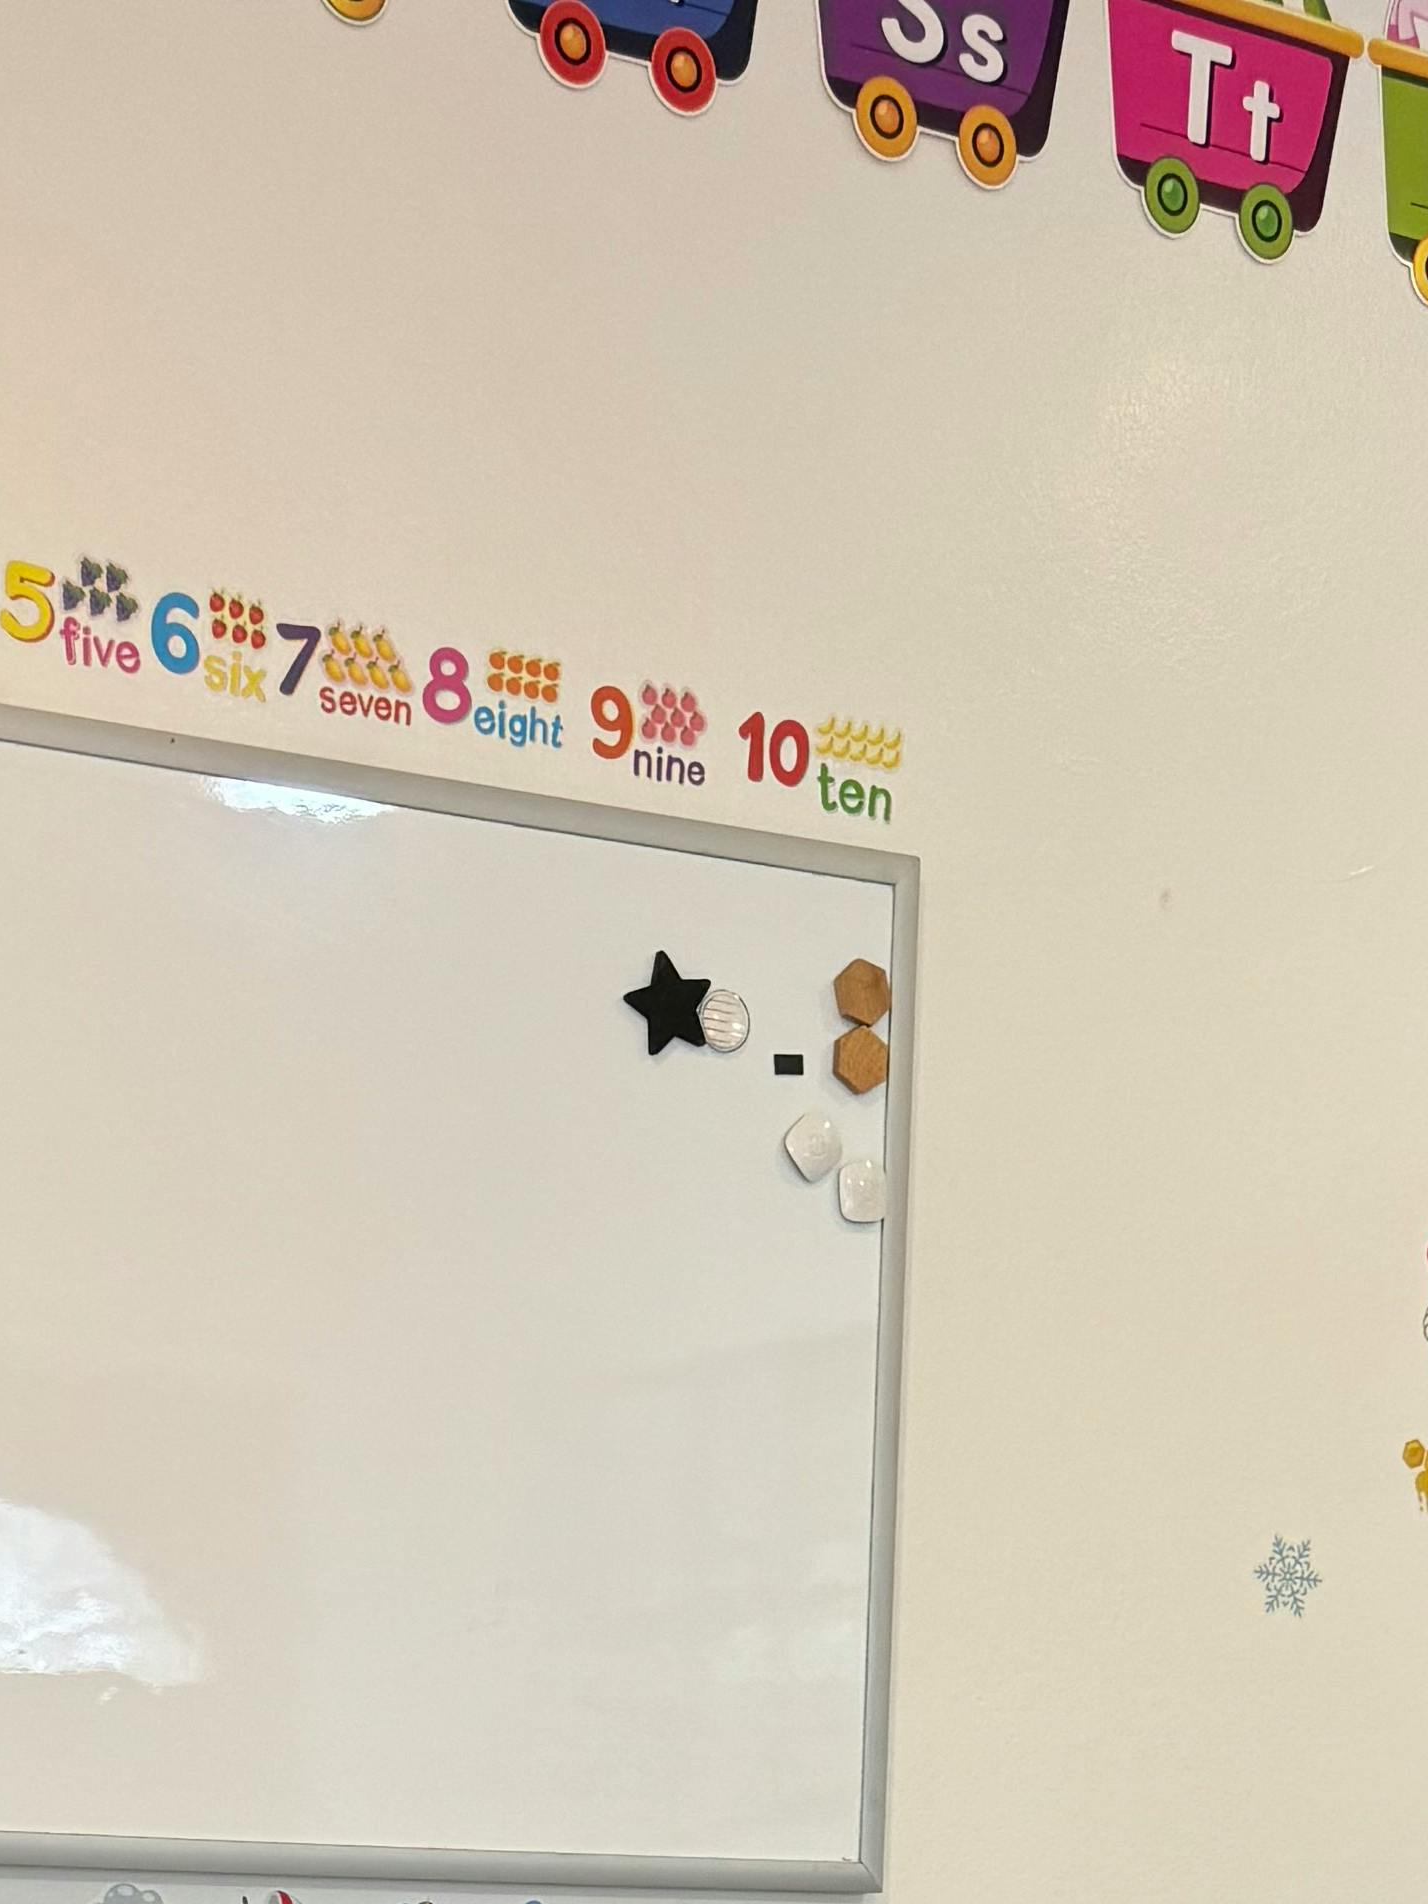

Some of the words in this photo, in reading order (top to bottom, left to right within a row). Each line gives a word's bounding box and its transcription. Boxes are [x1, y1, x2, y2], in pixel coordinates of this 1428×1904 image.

[1172, 28, 1282, 163] Tt
[0, 560, 56, 643] 5
[60, 616, 142, 674] five
[151, 591, 200, 675] 6
[203, 652, 266, 702] six
[276, 622, 322, 696] 7
[319, 686, 412, 726] seven
[422, 646, 472, 724] 8
[473, 700, 564, 749] eight
[590, 685, 634, 760] 9
[632, 746, 706, 786] nine
[738, 711, 810, 787] 10
[817, 762, 892, 824] ten
